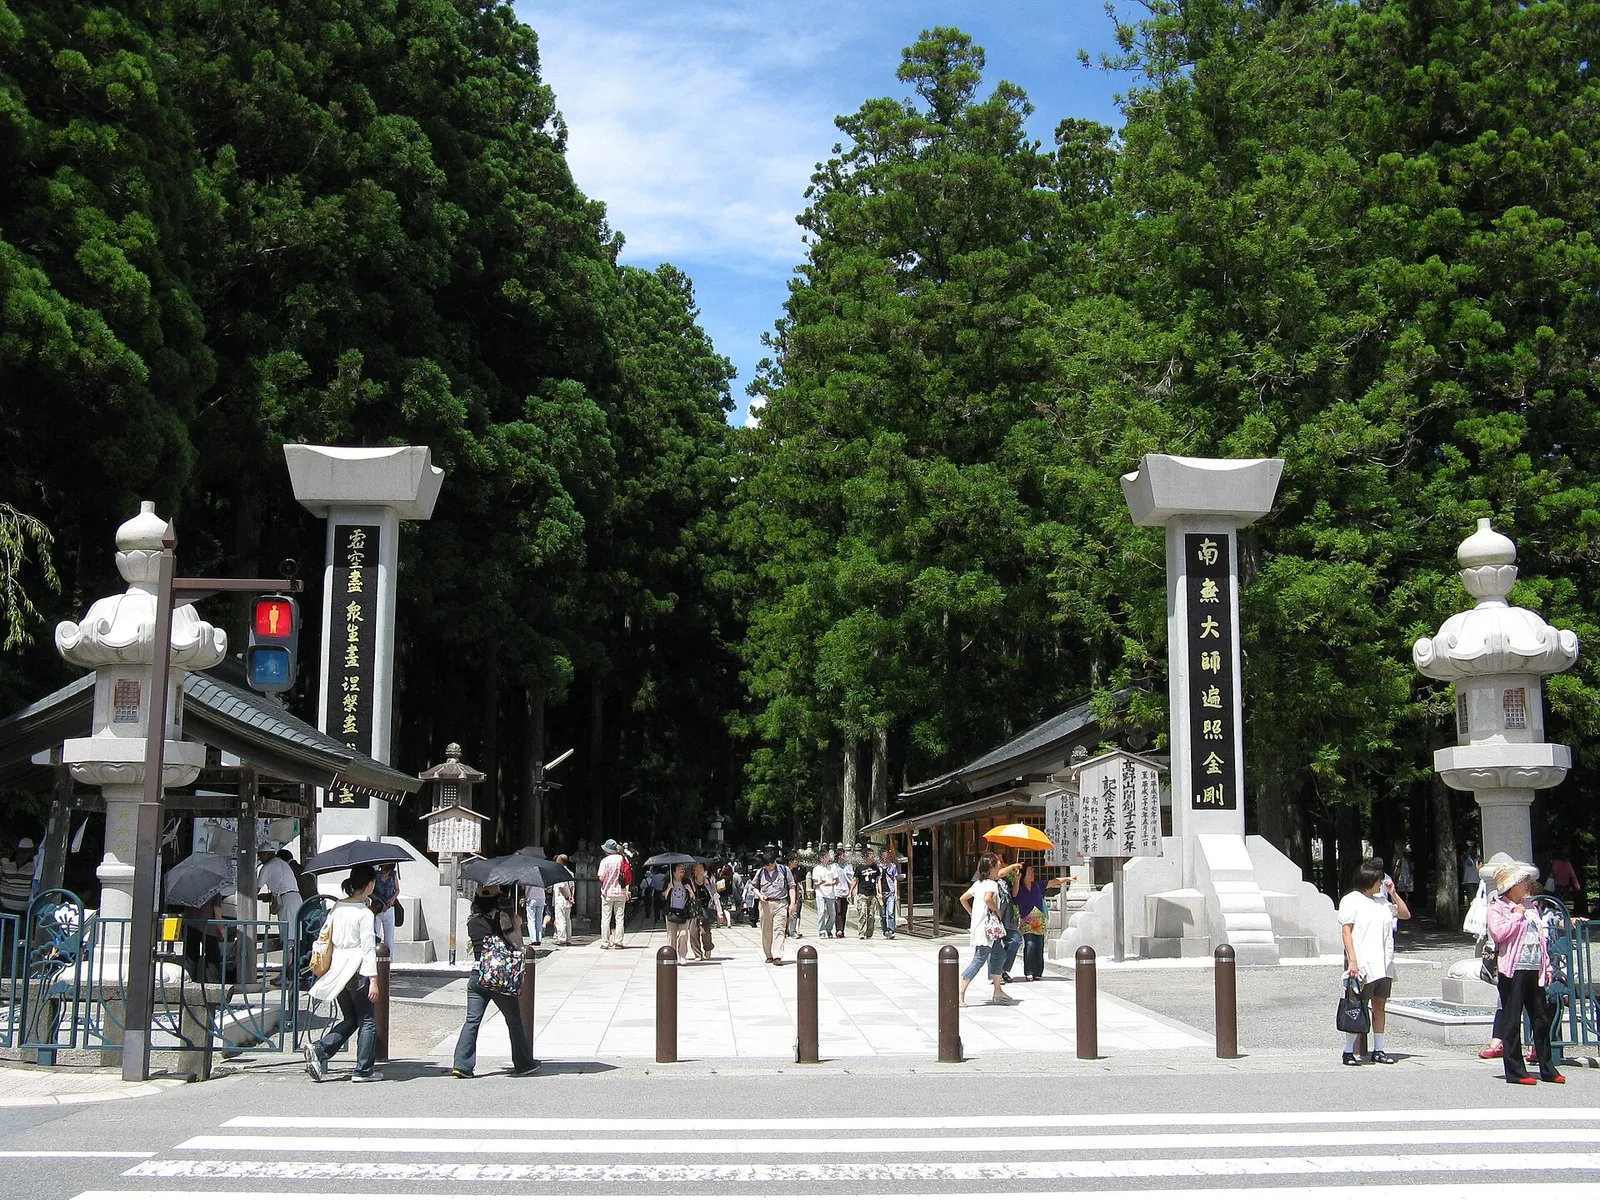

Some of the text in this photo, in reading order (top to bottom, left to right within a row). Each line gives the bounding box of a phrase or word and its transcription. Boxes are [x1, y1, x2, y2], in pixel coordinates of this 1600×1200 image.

[1197, 537, 1225, 806] 南無大師遍照金剛
